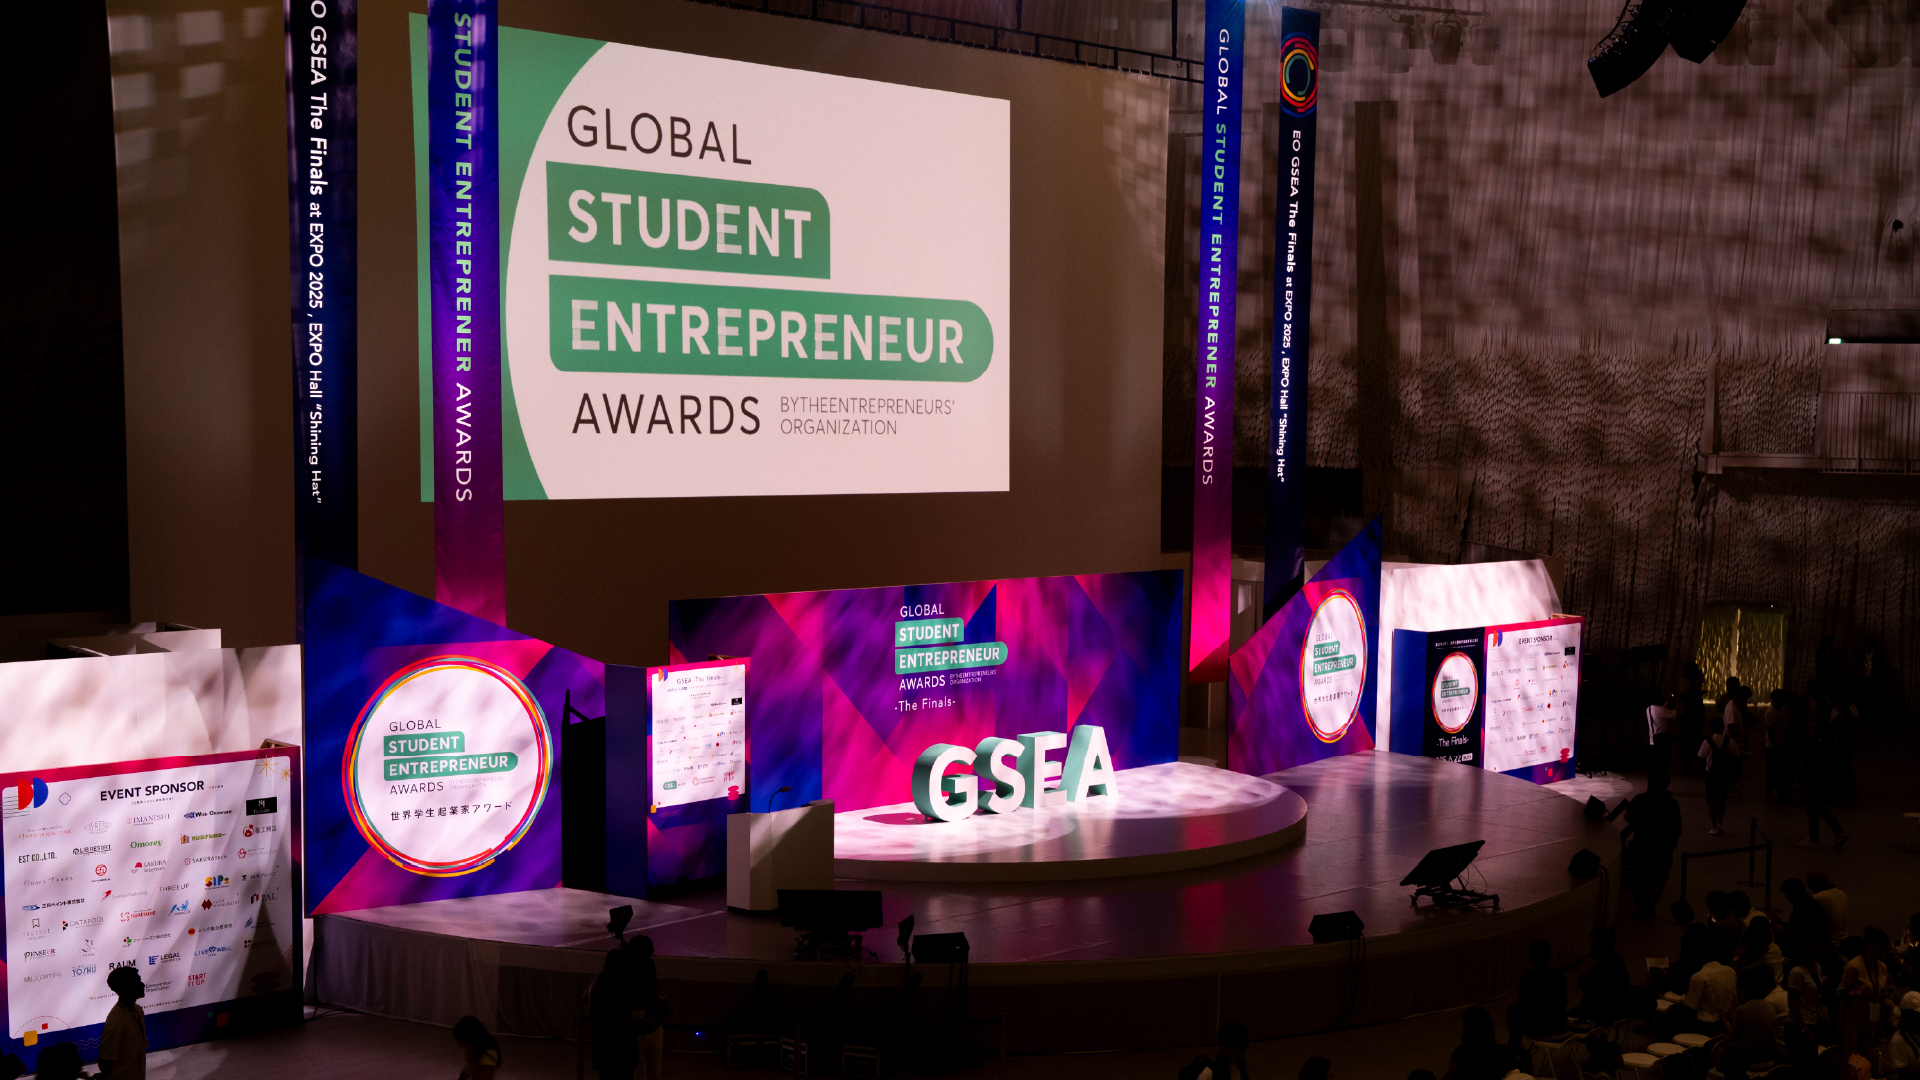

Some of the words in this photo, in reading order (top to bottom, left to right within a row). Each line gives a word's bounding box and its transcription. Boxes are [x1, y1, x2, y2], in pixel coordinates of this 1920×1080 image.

[310, 26, 327, 85] GSEA
[454, 12, 472, 150] STUDENT
[1217, 28, 1230, 115] GLOBAL
[310, 92, 328, 130] The
[567, 105, 752, 165] GLOBAL
[1292, 130, 1301, 152] EO
[310, 137, 328, 196] Finals
[1212, 123, 1227, 225] STUDENT
[1290, 156, 1300, 197] GSEA
[309, 202, 324, 218] at
[1288, 201, 1299, 228] The
[568, 189, 812, 259] STUDENT
[309, 223, 324, 267] EXPO
[1286, 232, 1297, 273] Finals
[455, 161, 472, 372] ENTREPRENER
[309, 272, 324, 308] 2025
[1286, 276, 1293, 287] at
[1205, 233, 1222, 389] ENTREPRENER
[1284, 290, 1293, 321] EXPO
[571, 299, 964, 364] ENTREPRENEUR
[1282, 323, 1292, 348] 2025
[309, 323, 323, 366] EXPO
[1280, 357, 1290, 388] EXPO
[309, 371, 323, 398] Hall
[1279, 389, 1289, 410] Hall
[572, 393, 761, 435] AWARDS
[780, 418, 898, 435] ORGANIZATION
[455, 383, 473, 502] AWARDS
[1202, 396, 1216, 485] AWARDS
[900, 603, 945, 618] GLOBAL
[899, 623, 960, 642] STUDENT
[1519, 637, 1533, 645] EVENT
[1533, 634, 1553, 643] SPONSOR
[899, 646, 1000, 669] ENTREPRENEUR
[1315, 644, 1339, 656] STUDENT
[1314, 657, 1354, 673] ENTREPRENEUR
[899, 674, 946, 691] AWARDS
[389, 719, 442, 732] GLOBAL
[389, 736, 460, 754] STUDENT
[389, 755, 508, 776] ENTREPRENEUR
[911, 724, 1119, 822] GSEA
[100, 787, 141, 801] EVENT
[145, 781, 204, 796] SPONSOR
[390, 781, 444, 795] AWARDS
[133, 813, 170, 823] IMANISHI
[391, 801, 512, 821] 世界学生起業家アワード
[130, 840, 162, 848] Omorey
[18, 855, 30, 863] EST
[31, 851, 57, 862] CO.,LTD.
[143, 859, 167, 867] SAKURA
[23, 928, 50, 936] TSUTSUI
[70, 916, 105, 927] DATAPOOL
[109, 959, 136, 970] RAUM
[160, 952, 180, 960] LEGAL
[188, 973, 206, 981] START
